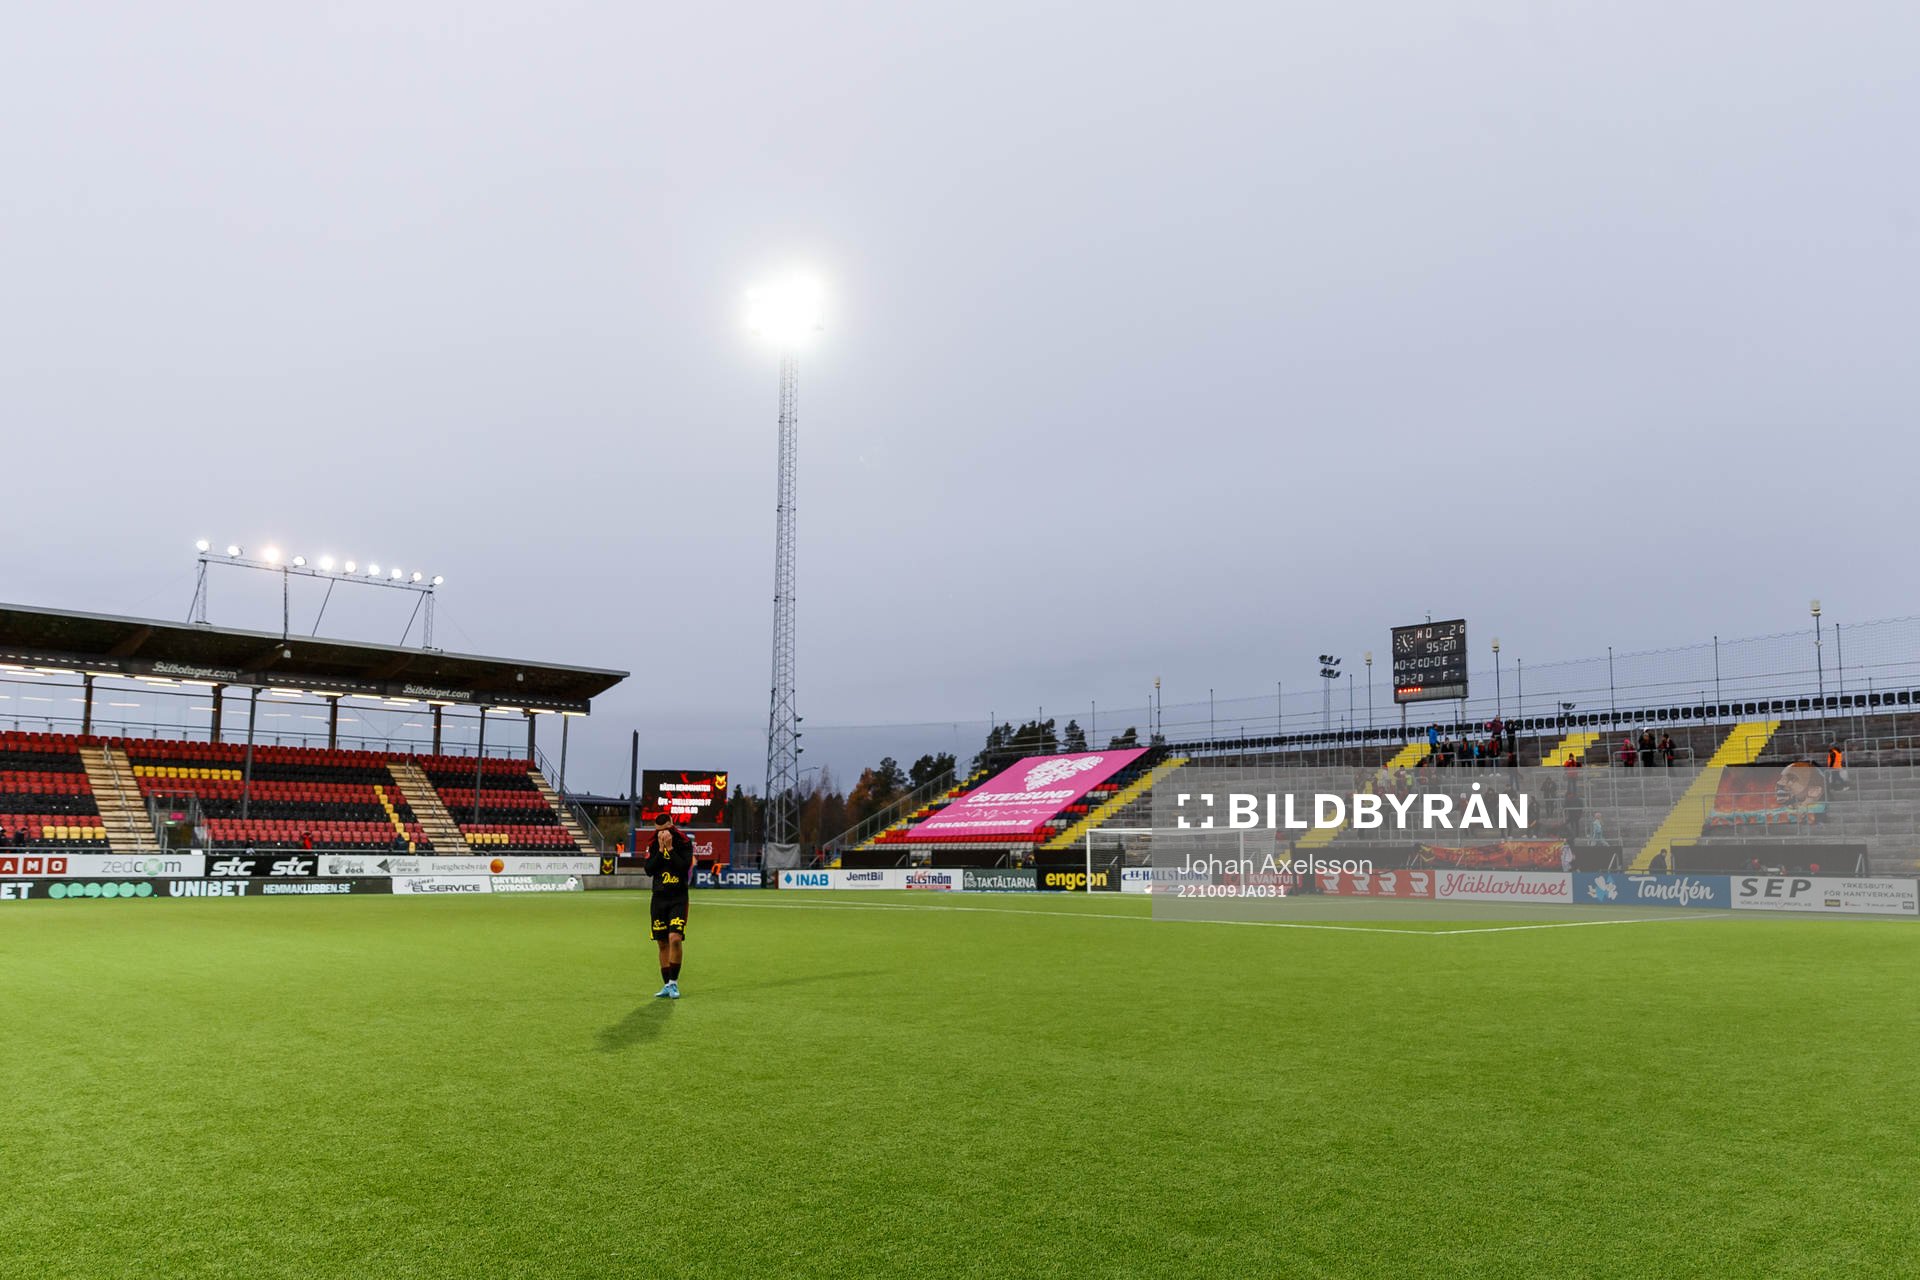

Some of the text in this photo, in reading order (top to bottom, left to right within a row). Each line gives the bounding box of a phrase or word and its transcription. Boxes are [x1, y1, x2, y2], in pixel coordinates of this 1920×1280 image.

[1449, 624, 1456, 636] 2
[152, 661, 237, 679] Bilbolaget.com
[402, 683, 470, 699] Bilbolaget.com
[967, 789, 1075, 803] ÖSTERSUND
[102, 857, 182, 875] zedcom
[210, 856, 256, 876] stc
[270, 856, 314, 876] stc
[796, 874, 830, 886] INAB
[846, 872, 884, 882] JemtBil
[976, 876, 1036, 888] TAKTÄLTARNA
[1046, 872, 1107, 890] engcon
[1440, 872, 1568, 896] Mäklarhuset
[169, 880, 249, 898] UNIBET
[263, 883, 351, 895] HEMMAKLUBBEN.SE
[412, 884, 481, 893] ELSERVICE
[1628, 876, 1714, 906] Tandfén
[1739, 878, 1812, 898] SEP
[1842, 882, 1894, 890] YRKESBUTIK
